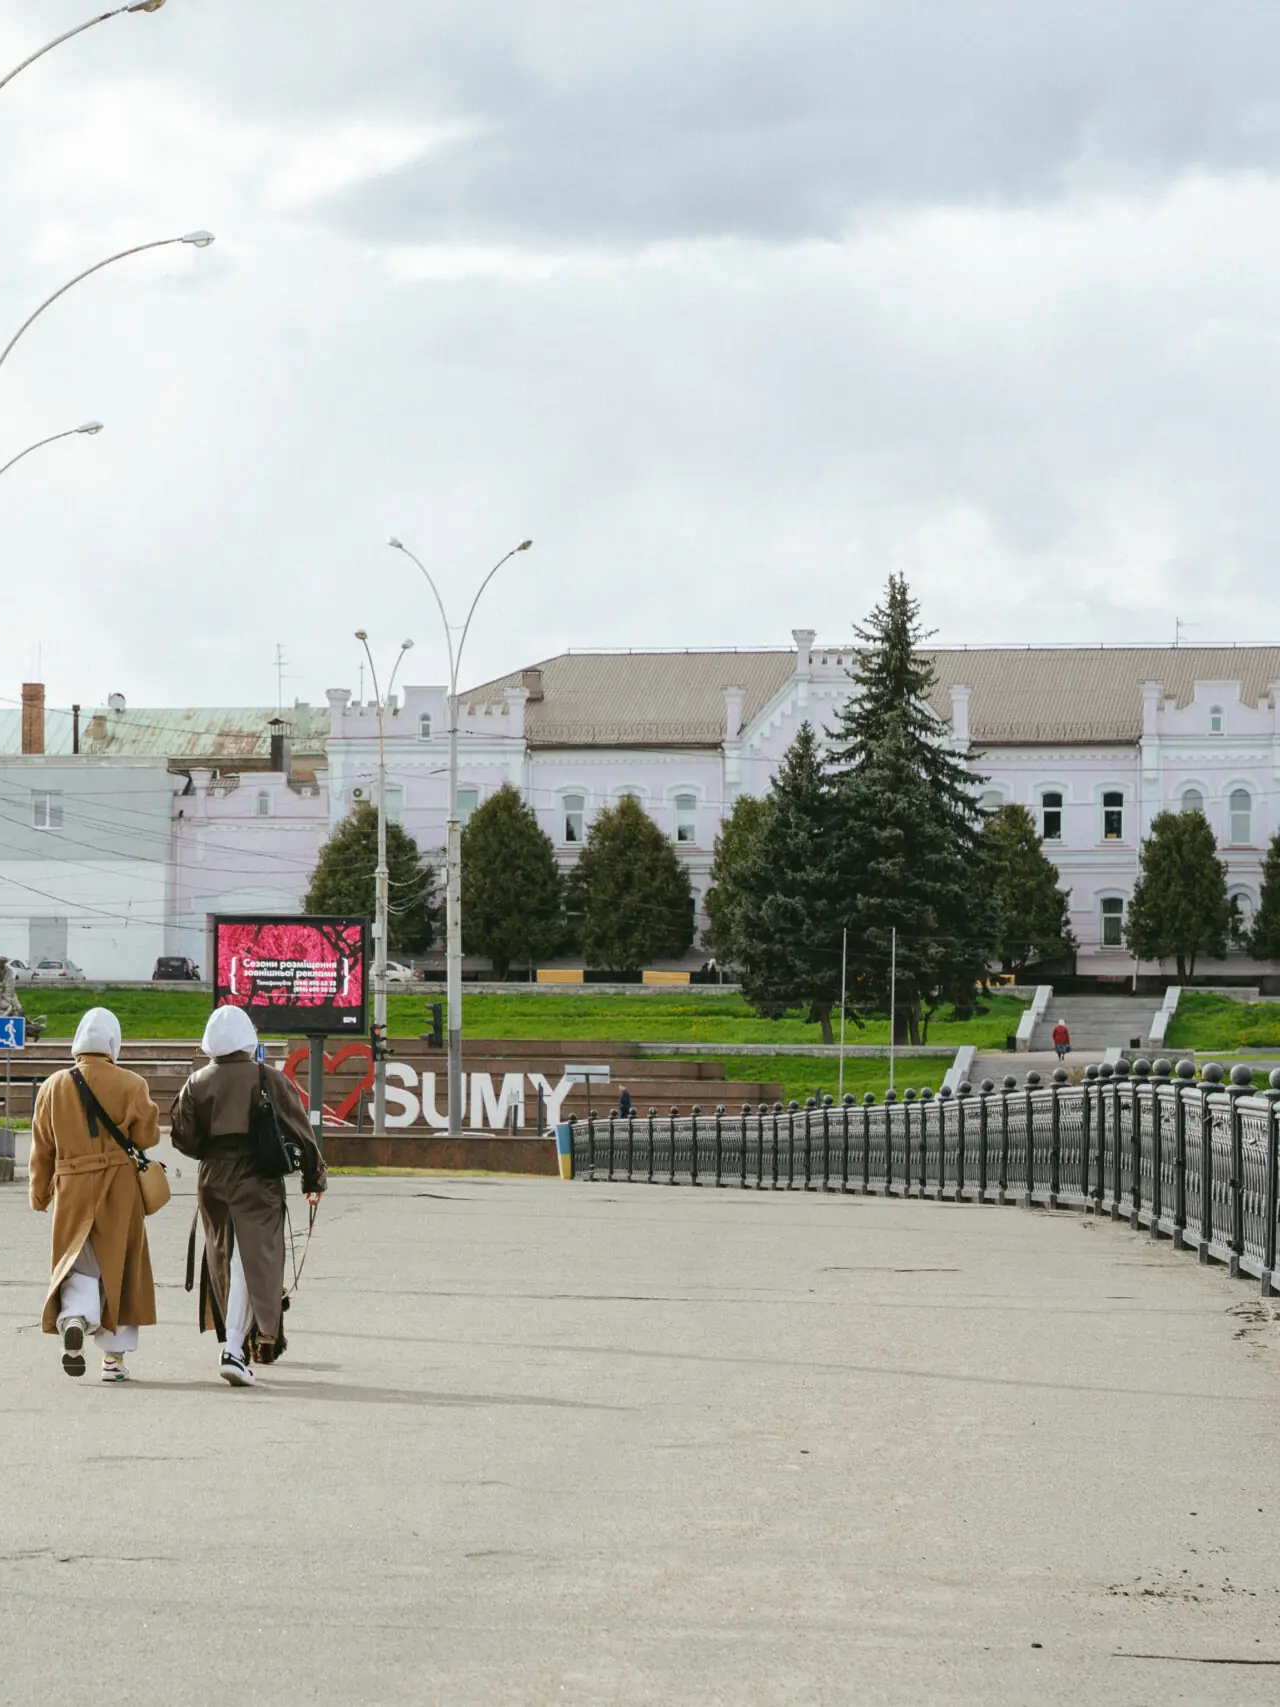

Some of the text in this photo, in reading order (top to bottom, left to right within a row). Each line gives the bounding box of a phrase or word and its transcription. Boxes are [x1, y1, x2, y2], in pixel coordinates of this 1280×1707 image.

[243, 958, 337, 970] Сезони розміщення
[243, 968, 295, 977] зовнішньої
[368, 1062, 576, 1129] SUMY
